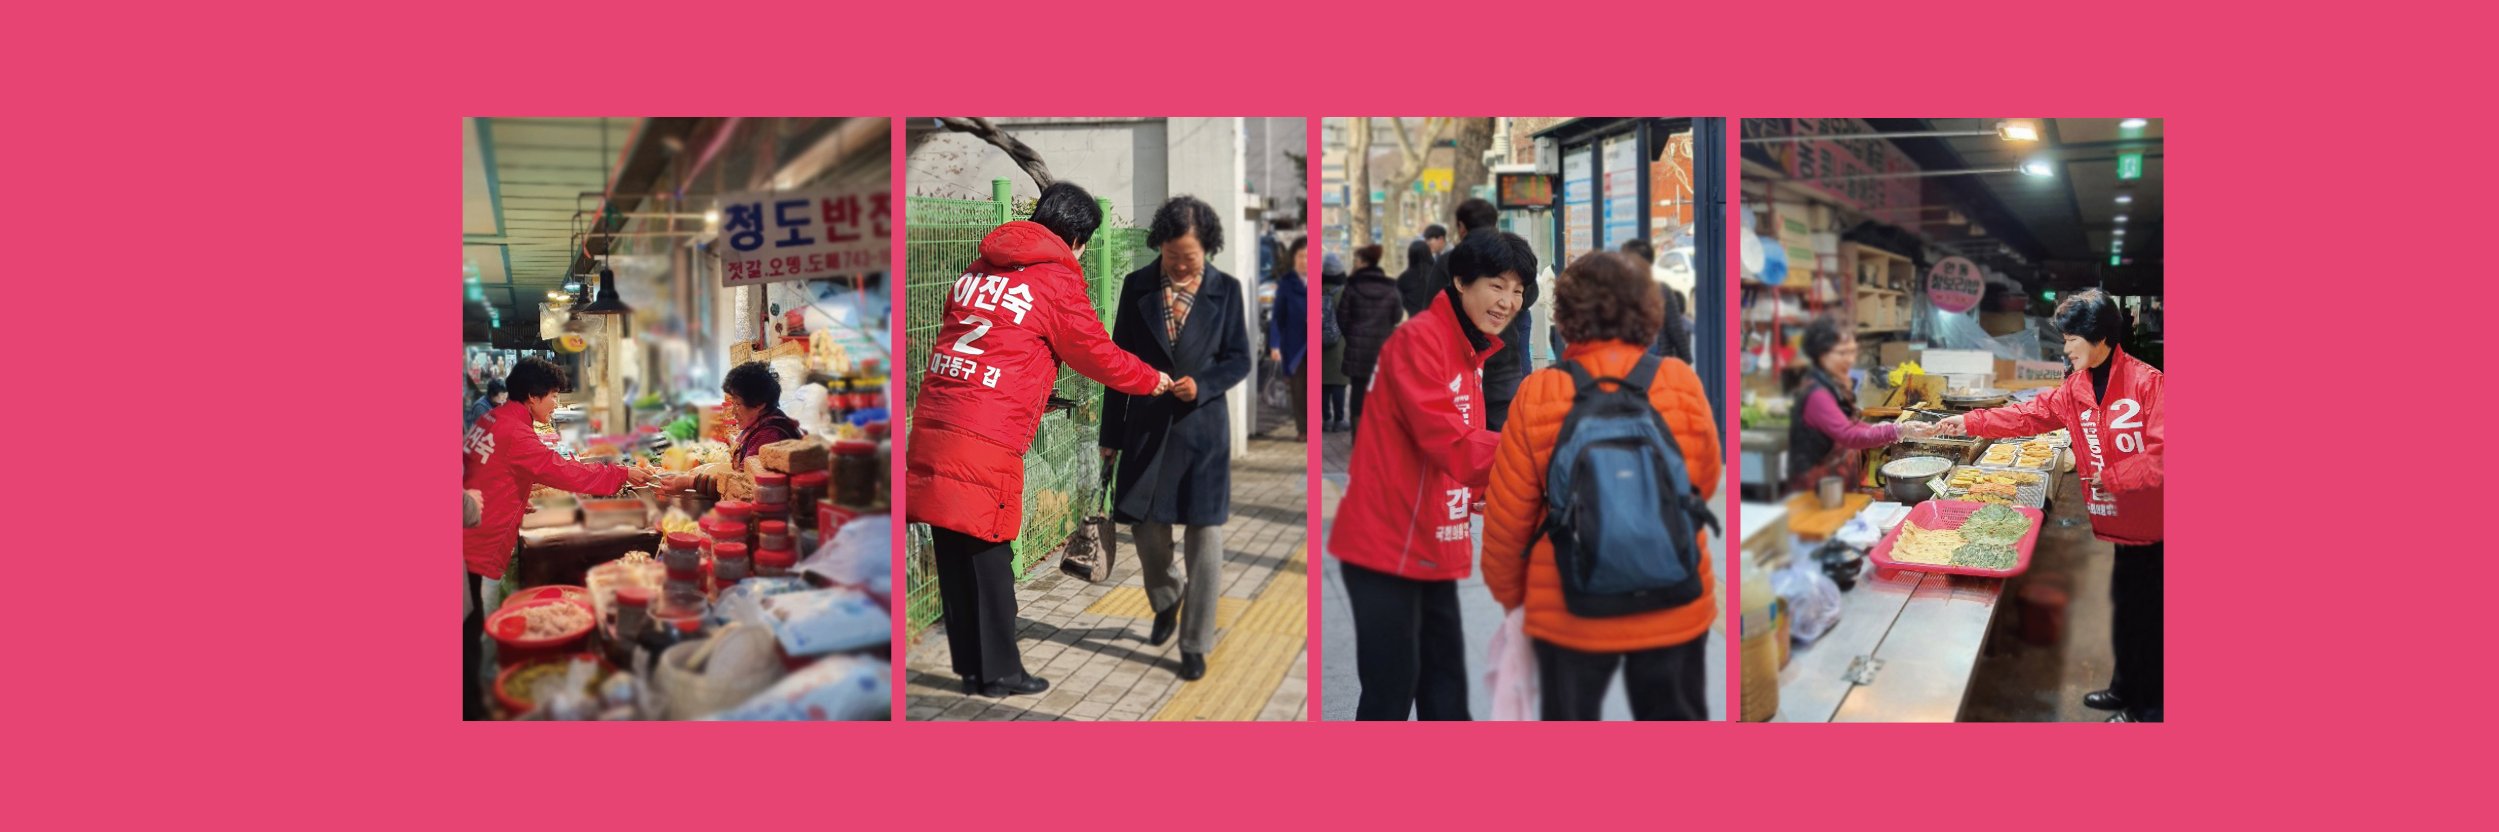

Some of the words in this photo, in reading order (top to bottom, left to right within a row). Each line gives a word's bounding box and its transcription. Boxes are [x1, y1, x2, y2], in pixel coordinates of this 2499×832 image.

[953, 272, 1034, 325] 이진숙
[952, 315, 992, 355] 2
[931, 354, 977, 379] 대구동구
[982, 366, 1001, 389] 갑
[2109, 398, 2144, 429] 2
[1446, 487, 1471, 520] 갑
